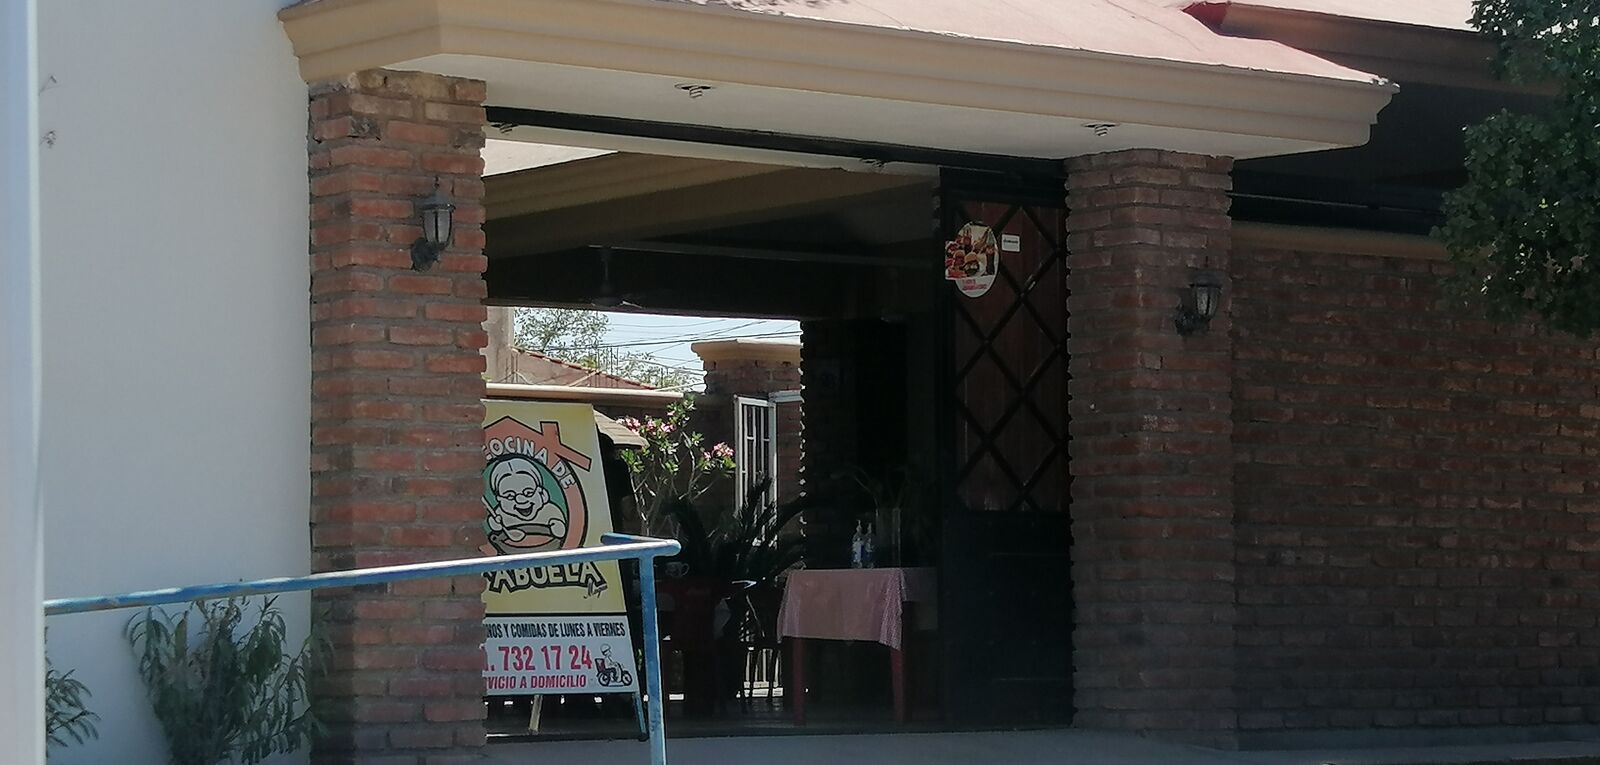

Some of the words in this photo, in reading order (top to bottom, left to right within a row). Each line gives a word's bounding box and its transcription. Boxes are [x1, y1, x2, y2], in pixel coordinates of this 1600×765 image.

[552, 459, 576, 490] DE
[484, 623, 503, 638] NOS
[504, 623, 511, 638] Y
[511, 623, 547, 638] COMIDAS
[549, 623, 560, 637] DE
[560, 622, 586, 637] LUNES
[587, 622, 593, 637] A
[593, 622, 626, 637] VIERNES
[498, 645, 536, 671] 732
[541, 645, 562, 670] 17
[568, 645, 592, 670] 24
[485, 676, 516, 689] VICIO
[519, 675, 528, 689] A
[531, 674, 587, 689] DOMICILIO
